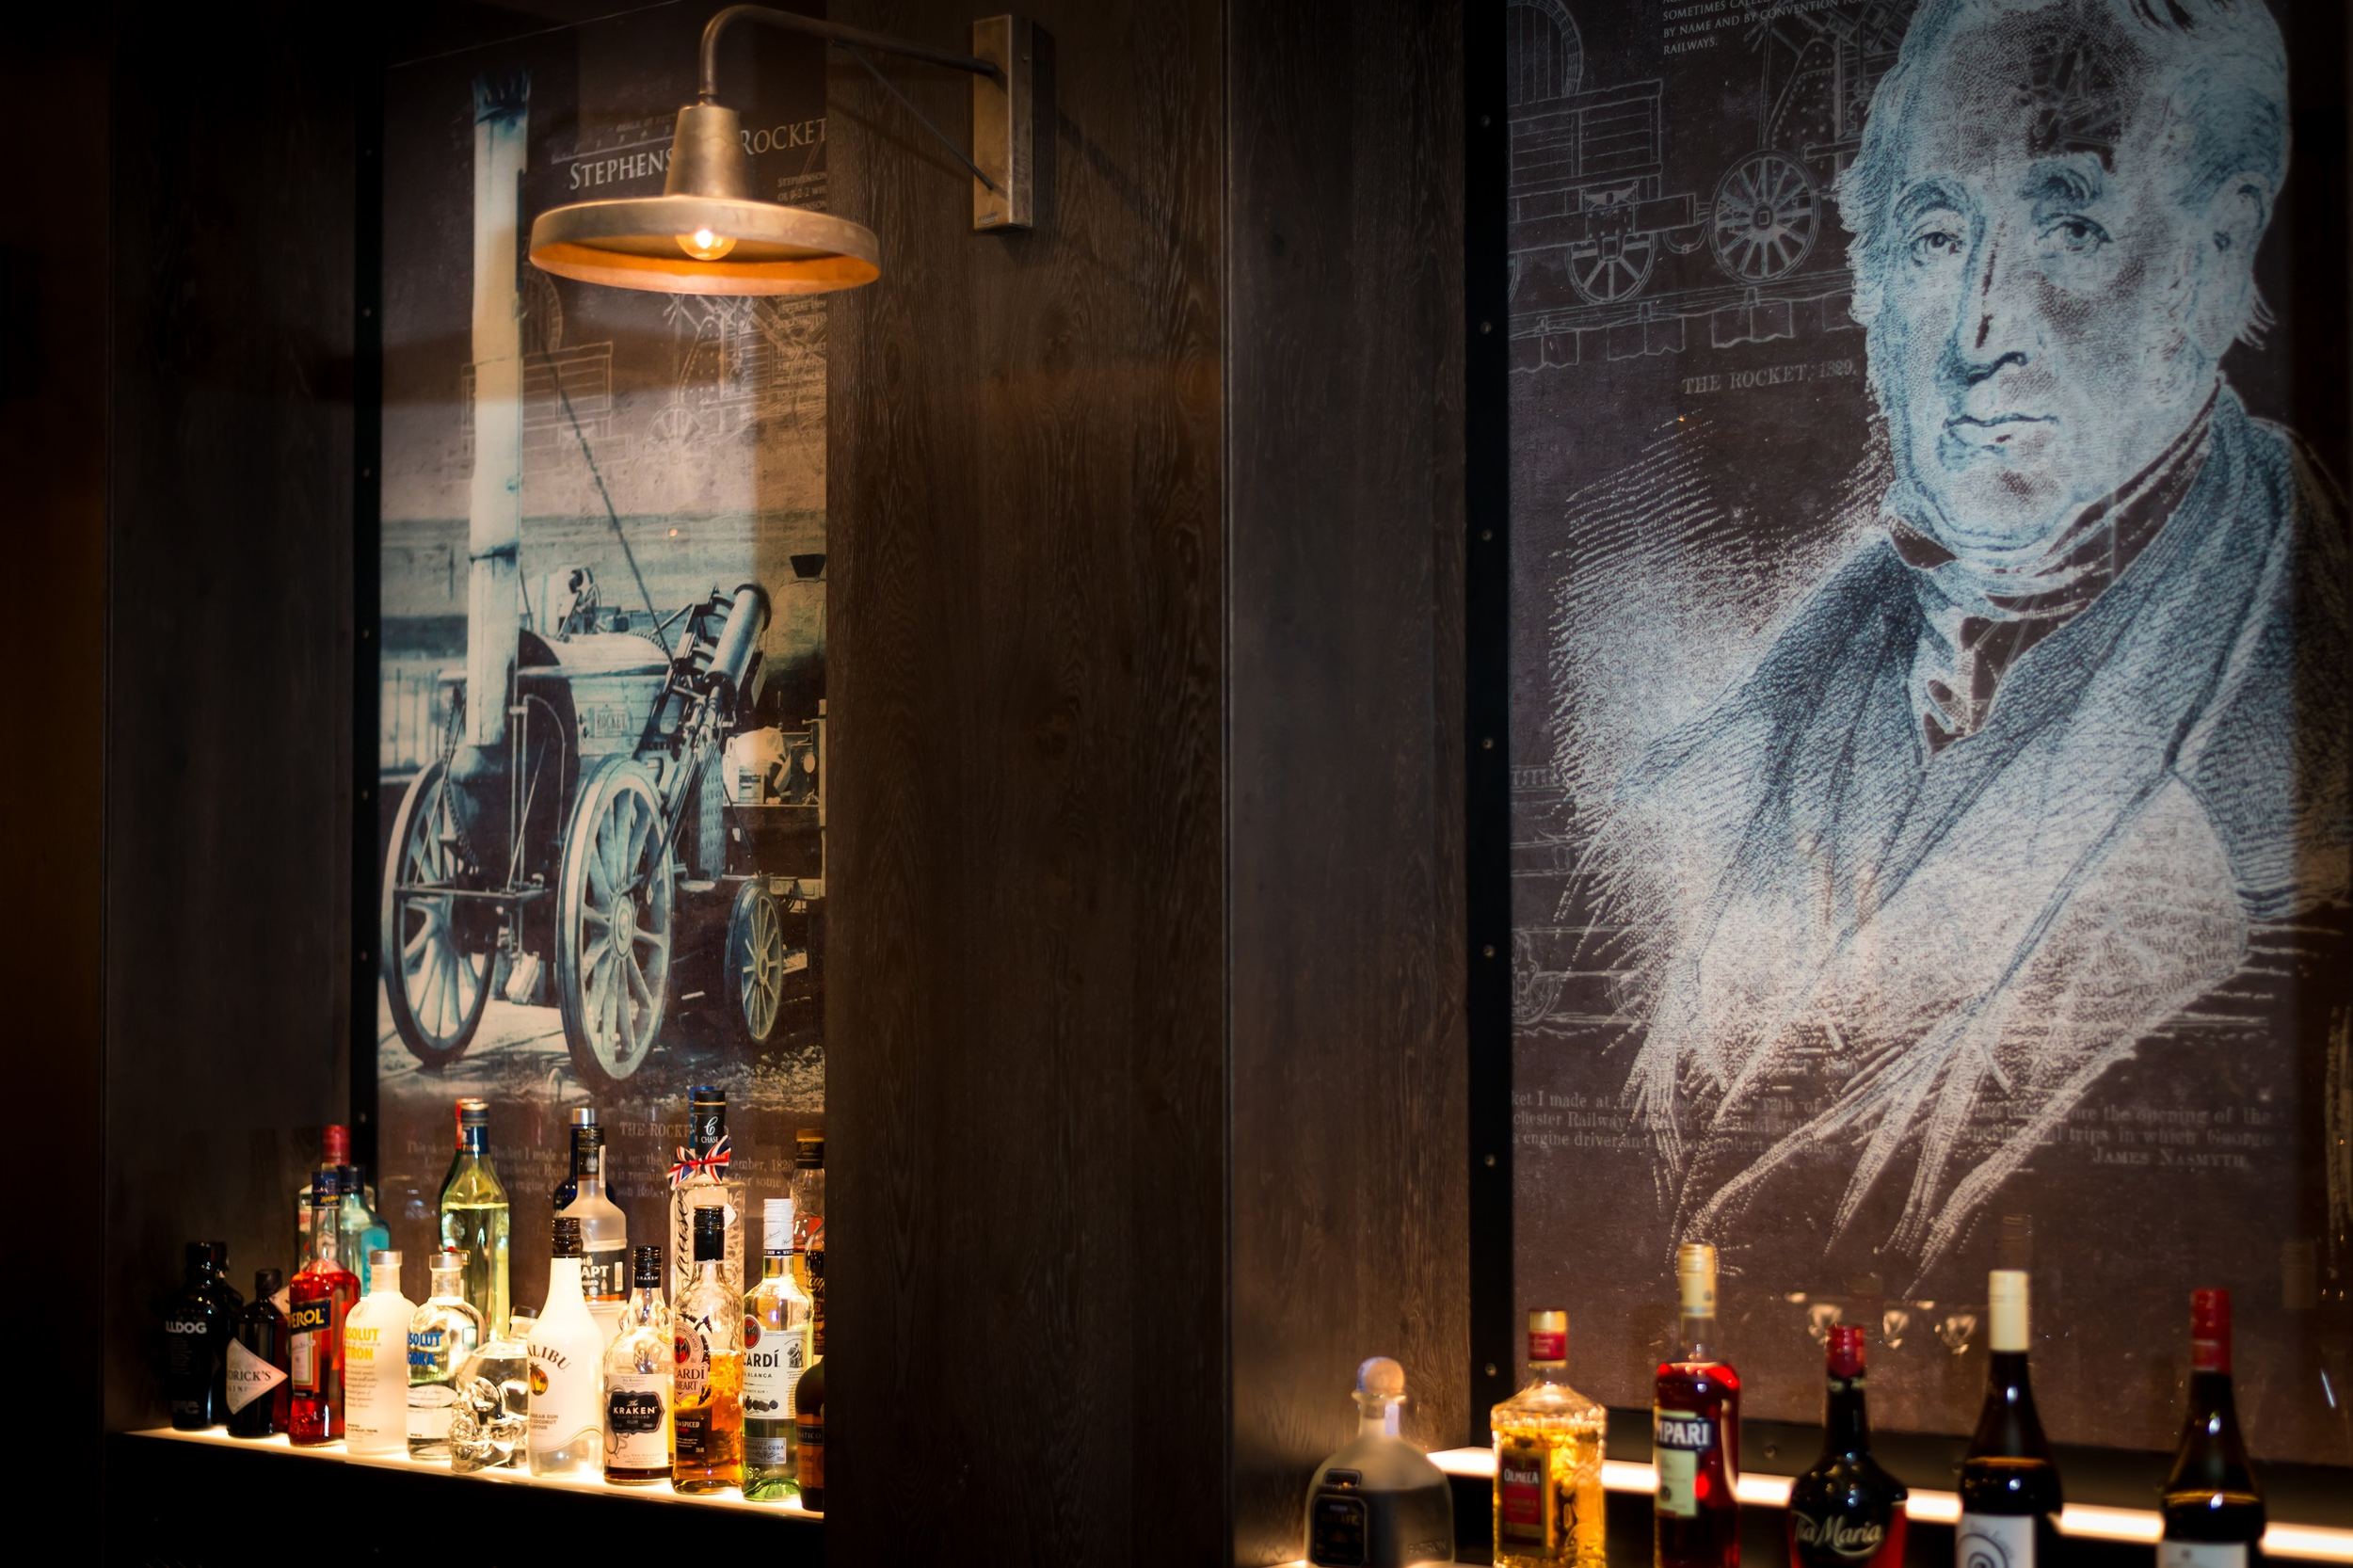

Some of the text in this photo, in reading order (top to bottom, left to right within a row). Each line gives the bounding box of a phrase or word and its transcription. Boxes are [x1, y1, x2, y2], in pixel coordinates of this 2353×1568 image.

[1662, 2, 1726, 22] SOMETIMES
[1663, 0, 1838, 39] BY NAME AND BY CONVENTION
[1663, 36, 1719, 56] RAILWAYS.
[741, 117, 828, 156] ROCKET
[1681, 374, 1721, 395] THE
[1549, 1092, 1588, 1108] made
[613, 1406, 656, 1415] KRAKEN
[1503, 1468, 1539, 1484] OLMECA
[1813, 1514, 1882, 1548] Maria
